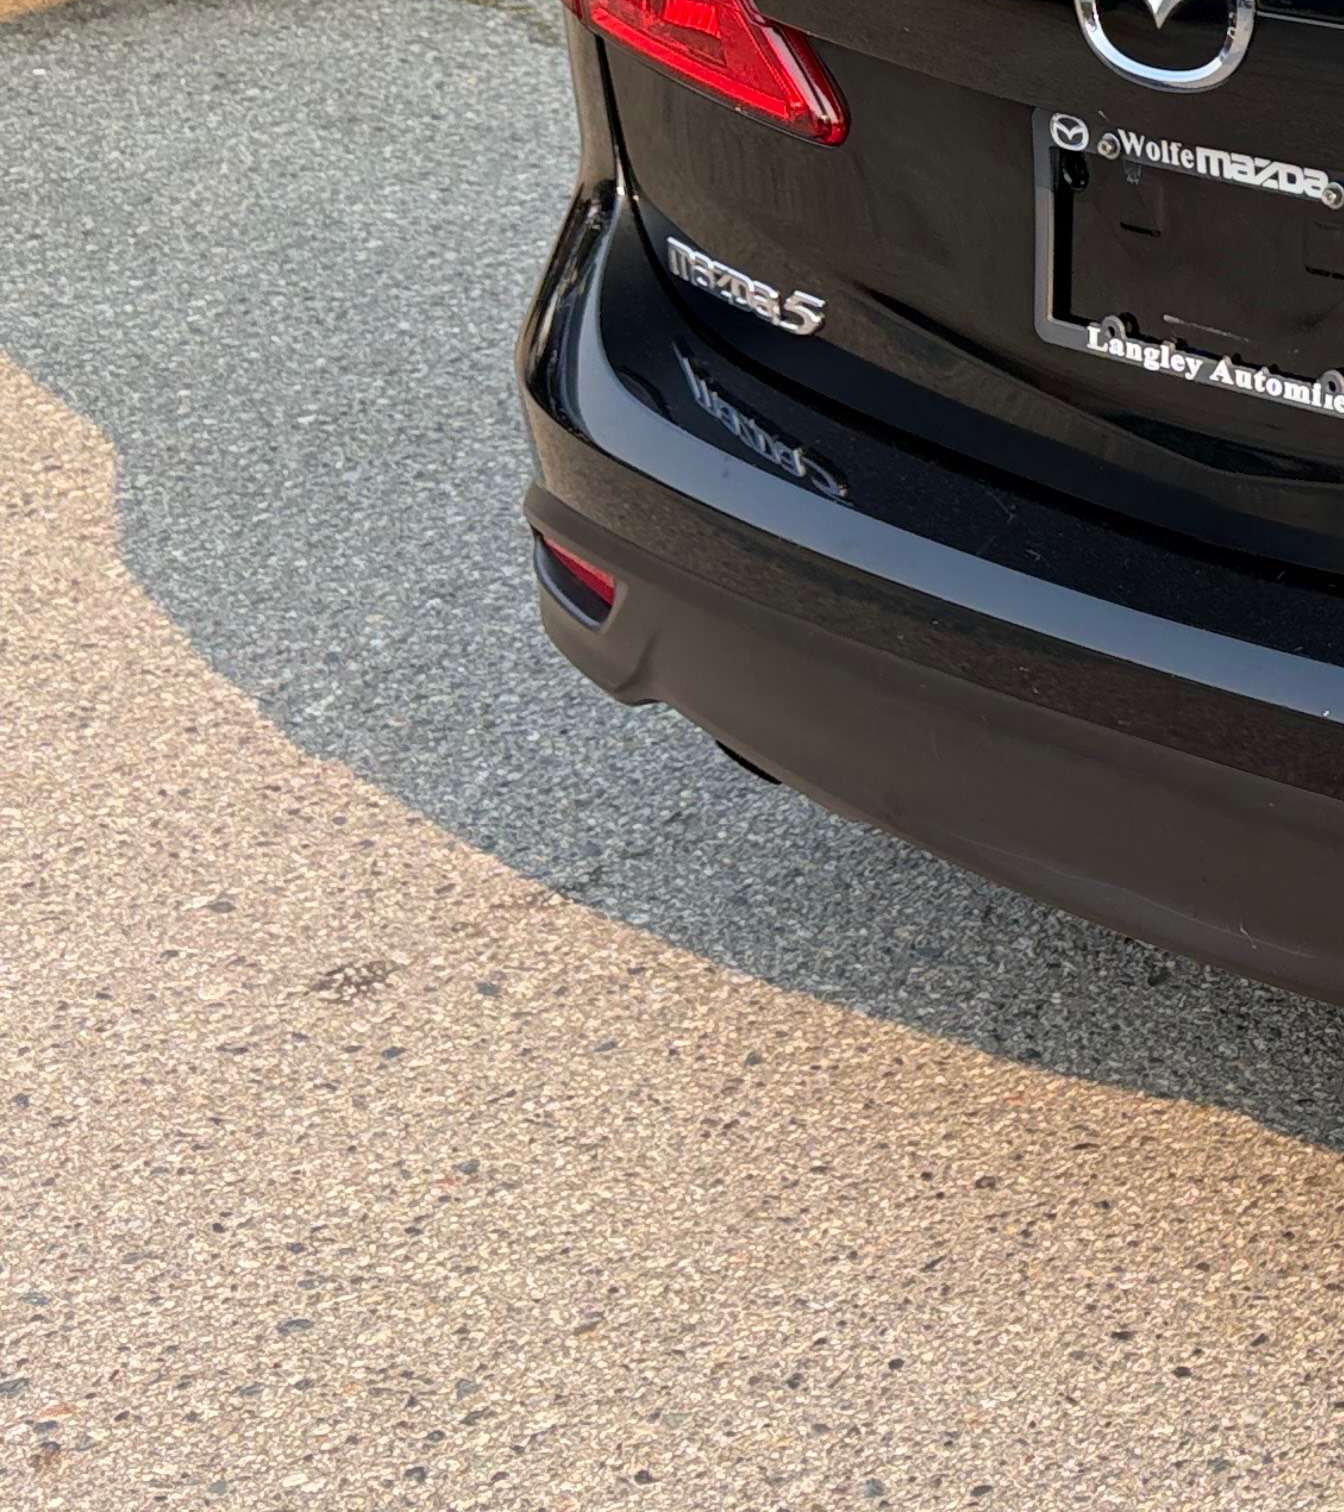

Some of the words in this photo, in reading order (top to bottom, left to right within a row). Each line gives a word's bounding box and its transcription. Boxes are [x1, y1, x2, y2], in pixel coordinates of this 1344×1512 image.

[1116, 127, 1197, 170] Wolfe
[1194, 145, 1331, 201] mazda
[1085, 324, 1203, 381] Langley
